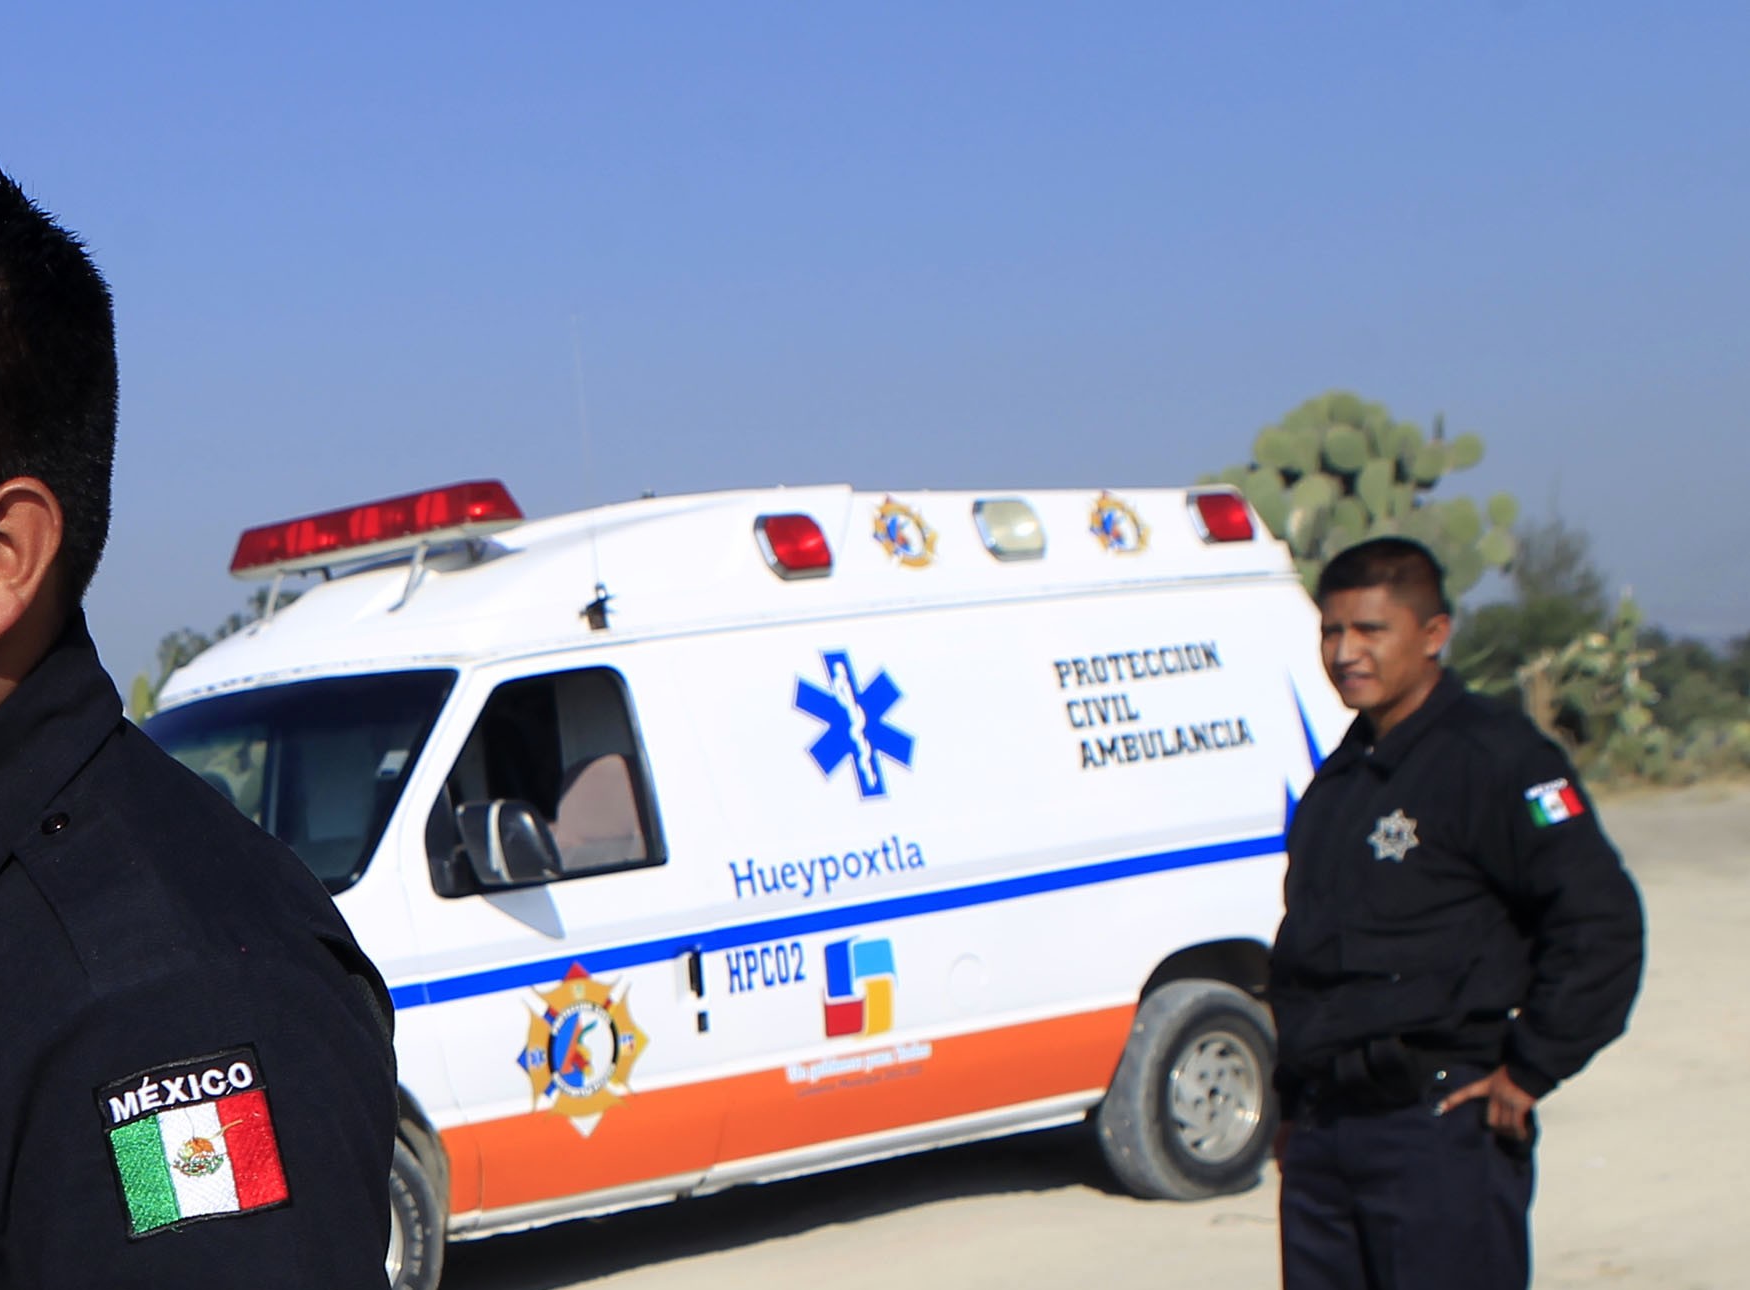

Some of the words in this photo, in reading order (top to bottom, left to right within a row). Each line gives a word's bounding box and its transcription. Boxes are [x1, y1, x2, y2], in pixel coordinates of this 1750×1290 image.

[1054, 641, 1222, 688] PROTECCION
[1066, 694, 1139, 728] CIVIL
[1079, 718, 1254, 769] AMBULANCIA
[729, 835, 925, 898] Hueypoxtla
[108, 1062, 253, 1123] MÉXICO
